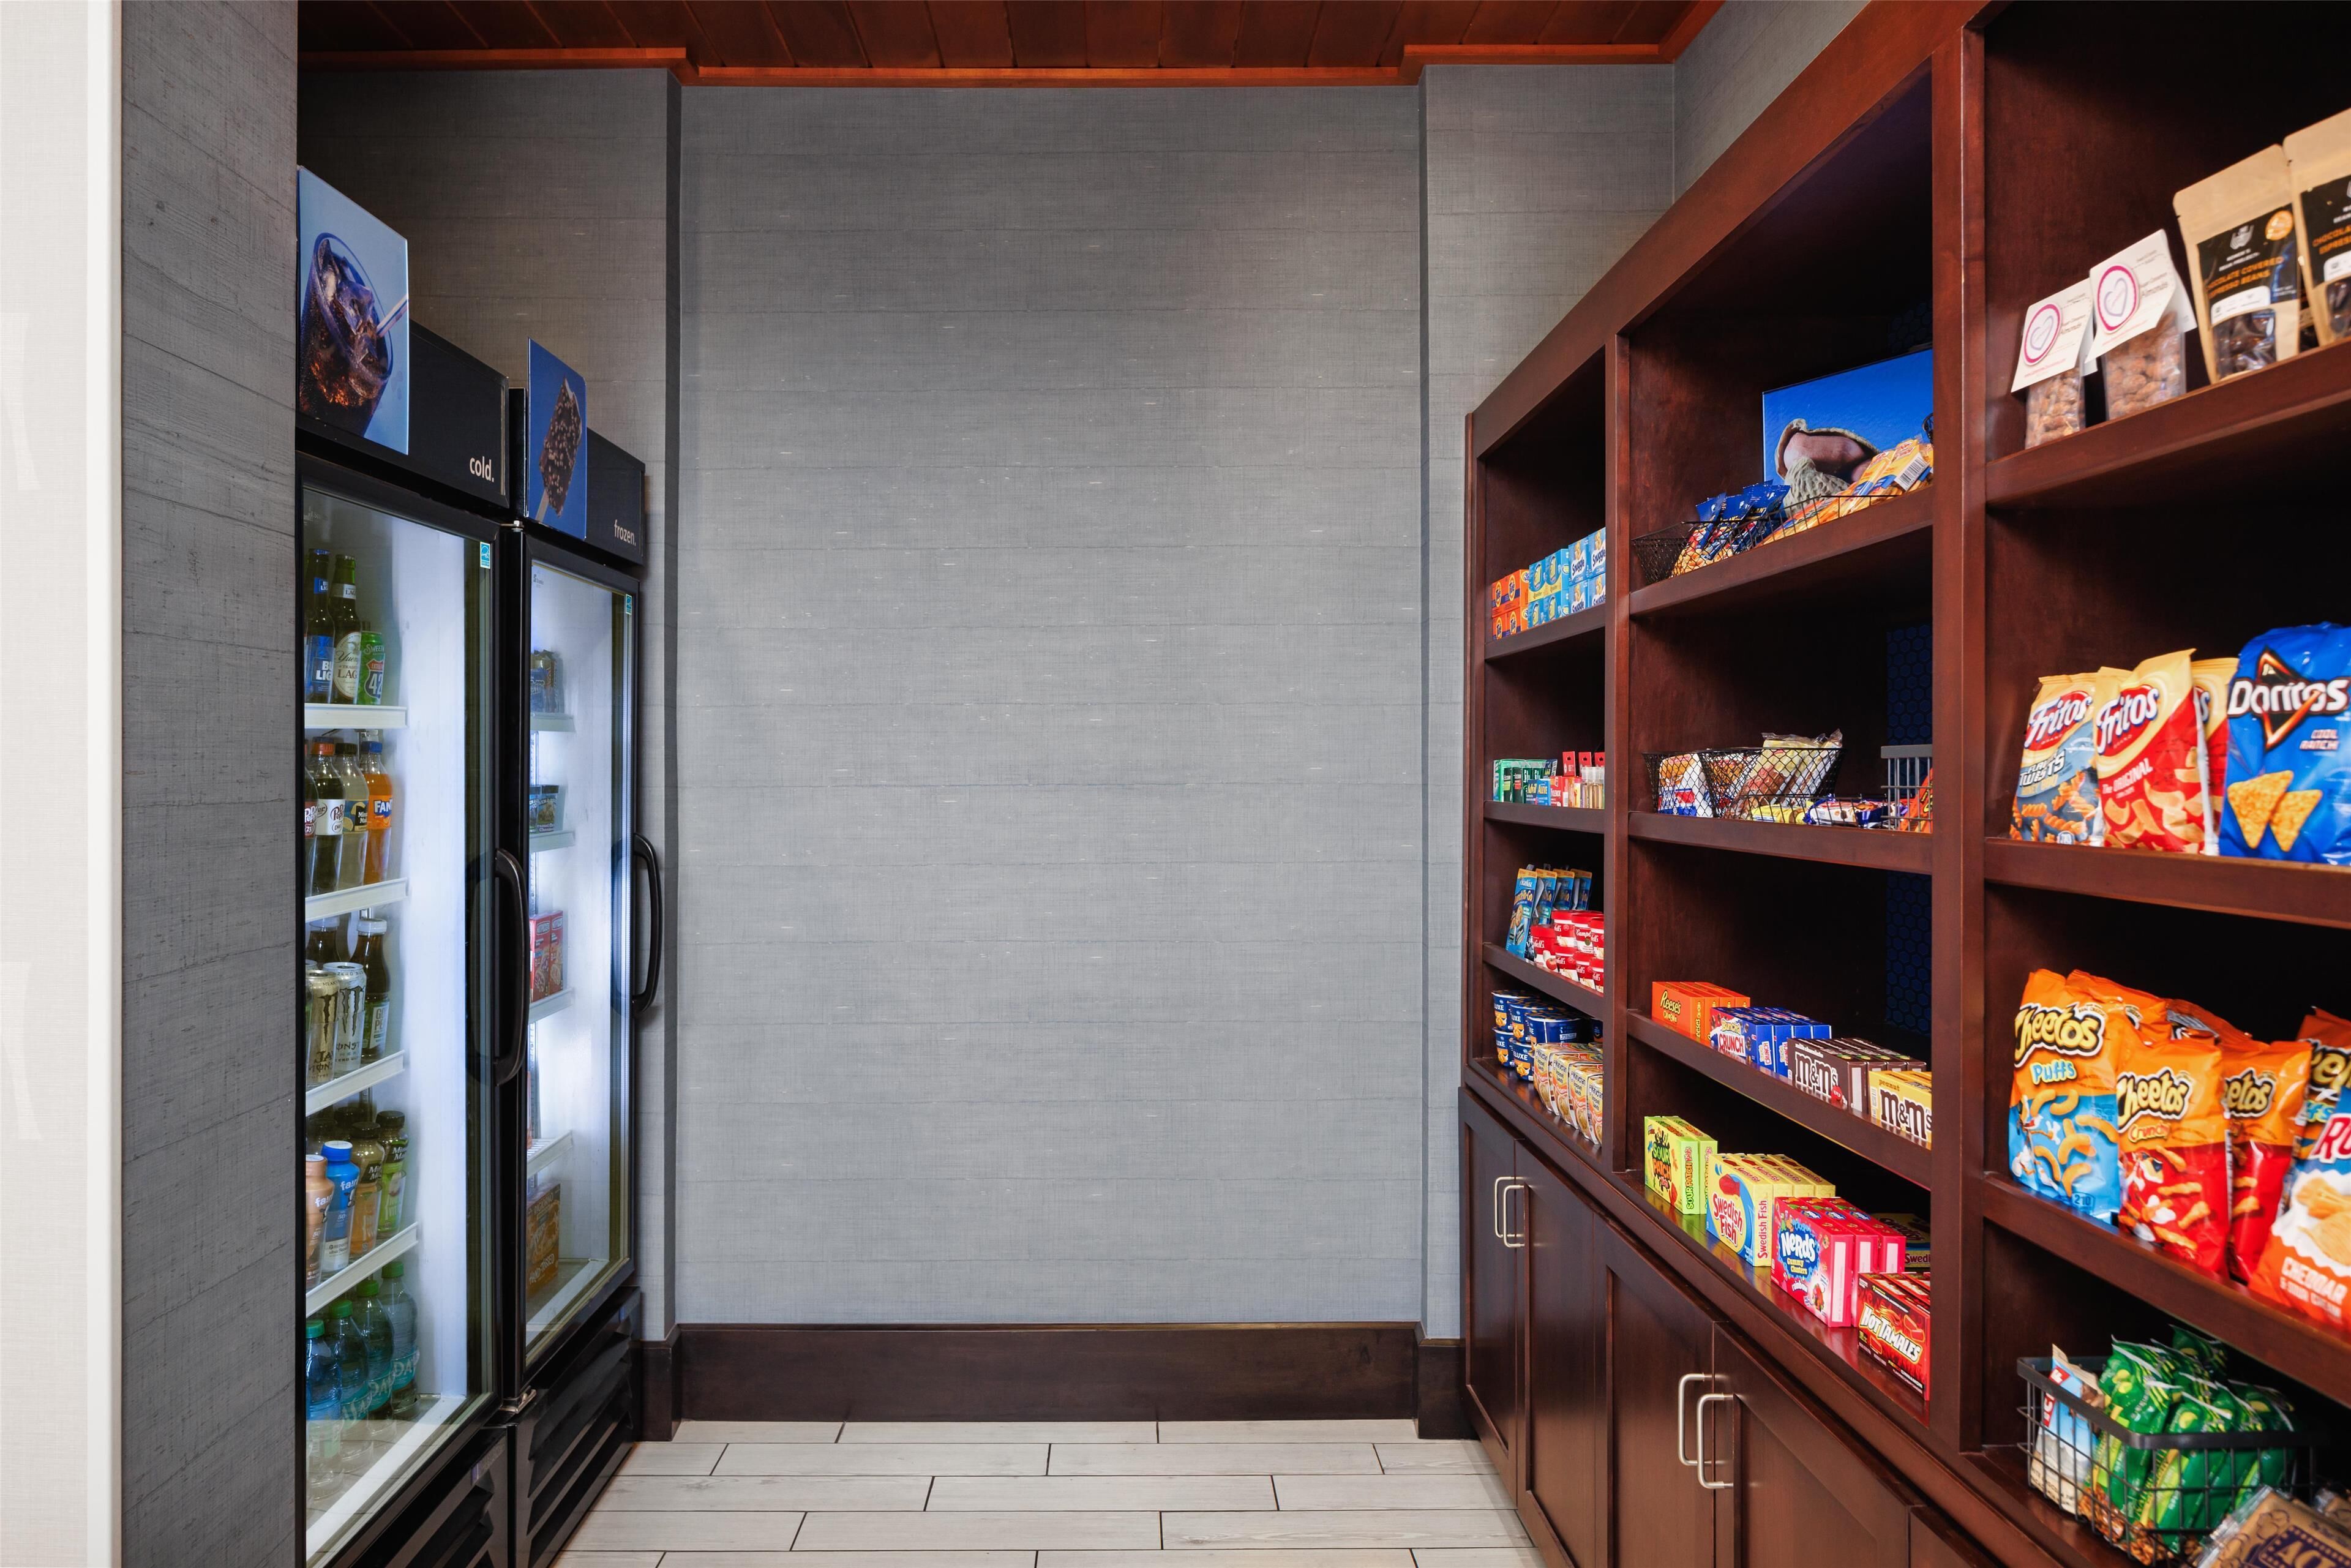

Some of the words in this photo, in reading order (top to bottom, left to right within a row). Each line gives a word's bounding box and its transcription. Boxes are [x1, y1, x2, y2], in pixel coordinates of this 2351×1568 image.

[470, 456, 494, 482] cold.
[614, 519, 636, 546] frozen.
[1572, 557, 1584, 576] Snuggle
[2227, 678, 2350, 716] Doritos
[2024, 696, 2092, 748] Fritos
[2097, 687, 2159, 755] Fritos
[2300, 740, 2339, 751] RANCH
[2311, 729, 2339, 740] COOL
[2019, 749, 2066, 787] TWISTS
[2113, 757, 2153, 792] ORIGINAL
[1660, 990, 1682, 1015] Reese's
[1719, 1033, 1744, 1054] CRUNCH
[1879, 1079, 1900, 1092] peanut
[2031, 1060, 2077, 1085] Puffs
[1653, 1142, 1670, 1164] SOUR
[1653, 1159, 1671, 1182] PATCH
[1712, 1193, 1743, 1236] Swedish
[1758, 1199, 1768, 1219] Fish
[1719, 1214, 1738, 1247] Fish
[1758, 1221, 1768, 1259] Swedish
[2282, 1256, 2348, 1306] CHEDDAR
[1860, 1304, 1882, 1334] HOT
[1877, 1316, 1922, 1362] TAMALES
